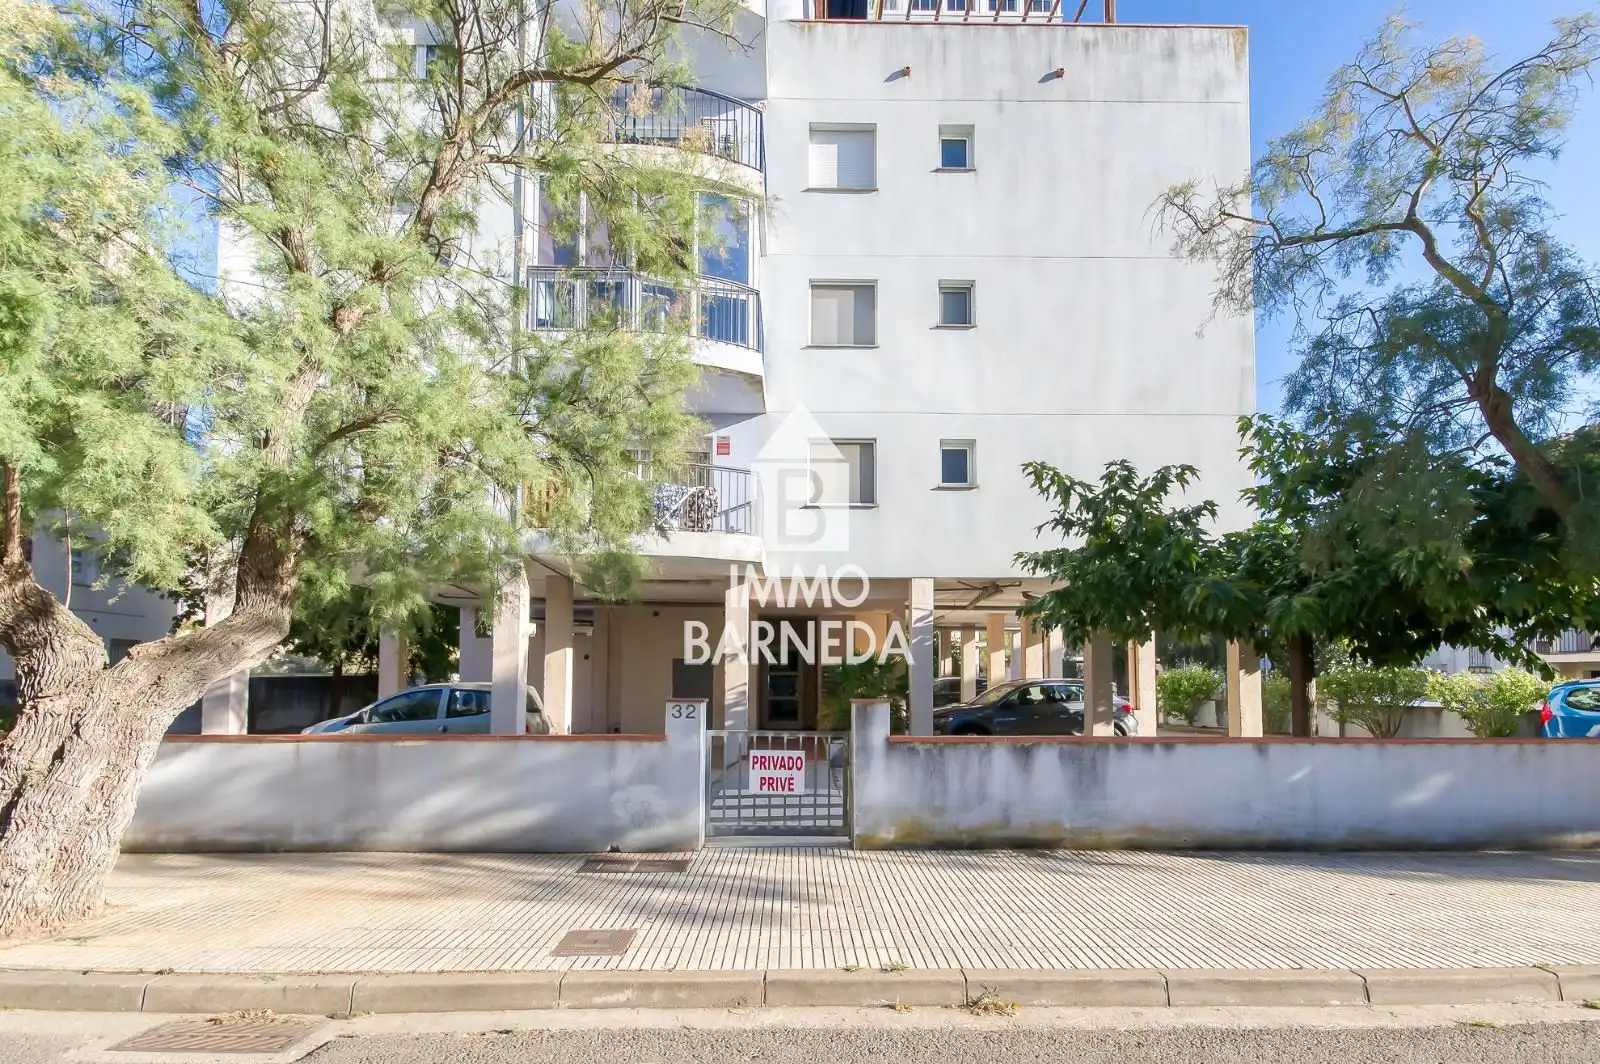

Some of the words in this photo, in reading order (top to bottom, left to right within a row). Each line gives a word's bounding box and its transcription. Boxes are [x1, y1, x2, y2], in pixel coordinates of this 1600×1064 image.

[671, 704, 697, 719] 32
[751, 755, 804, 772] PRIVADO
[759, 774, 795, 792] PRIVÉ
